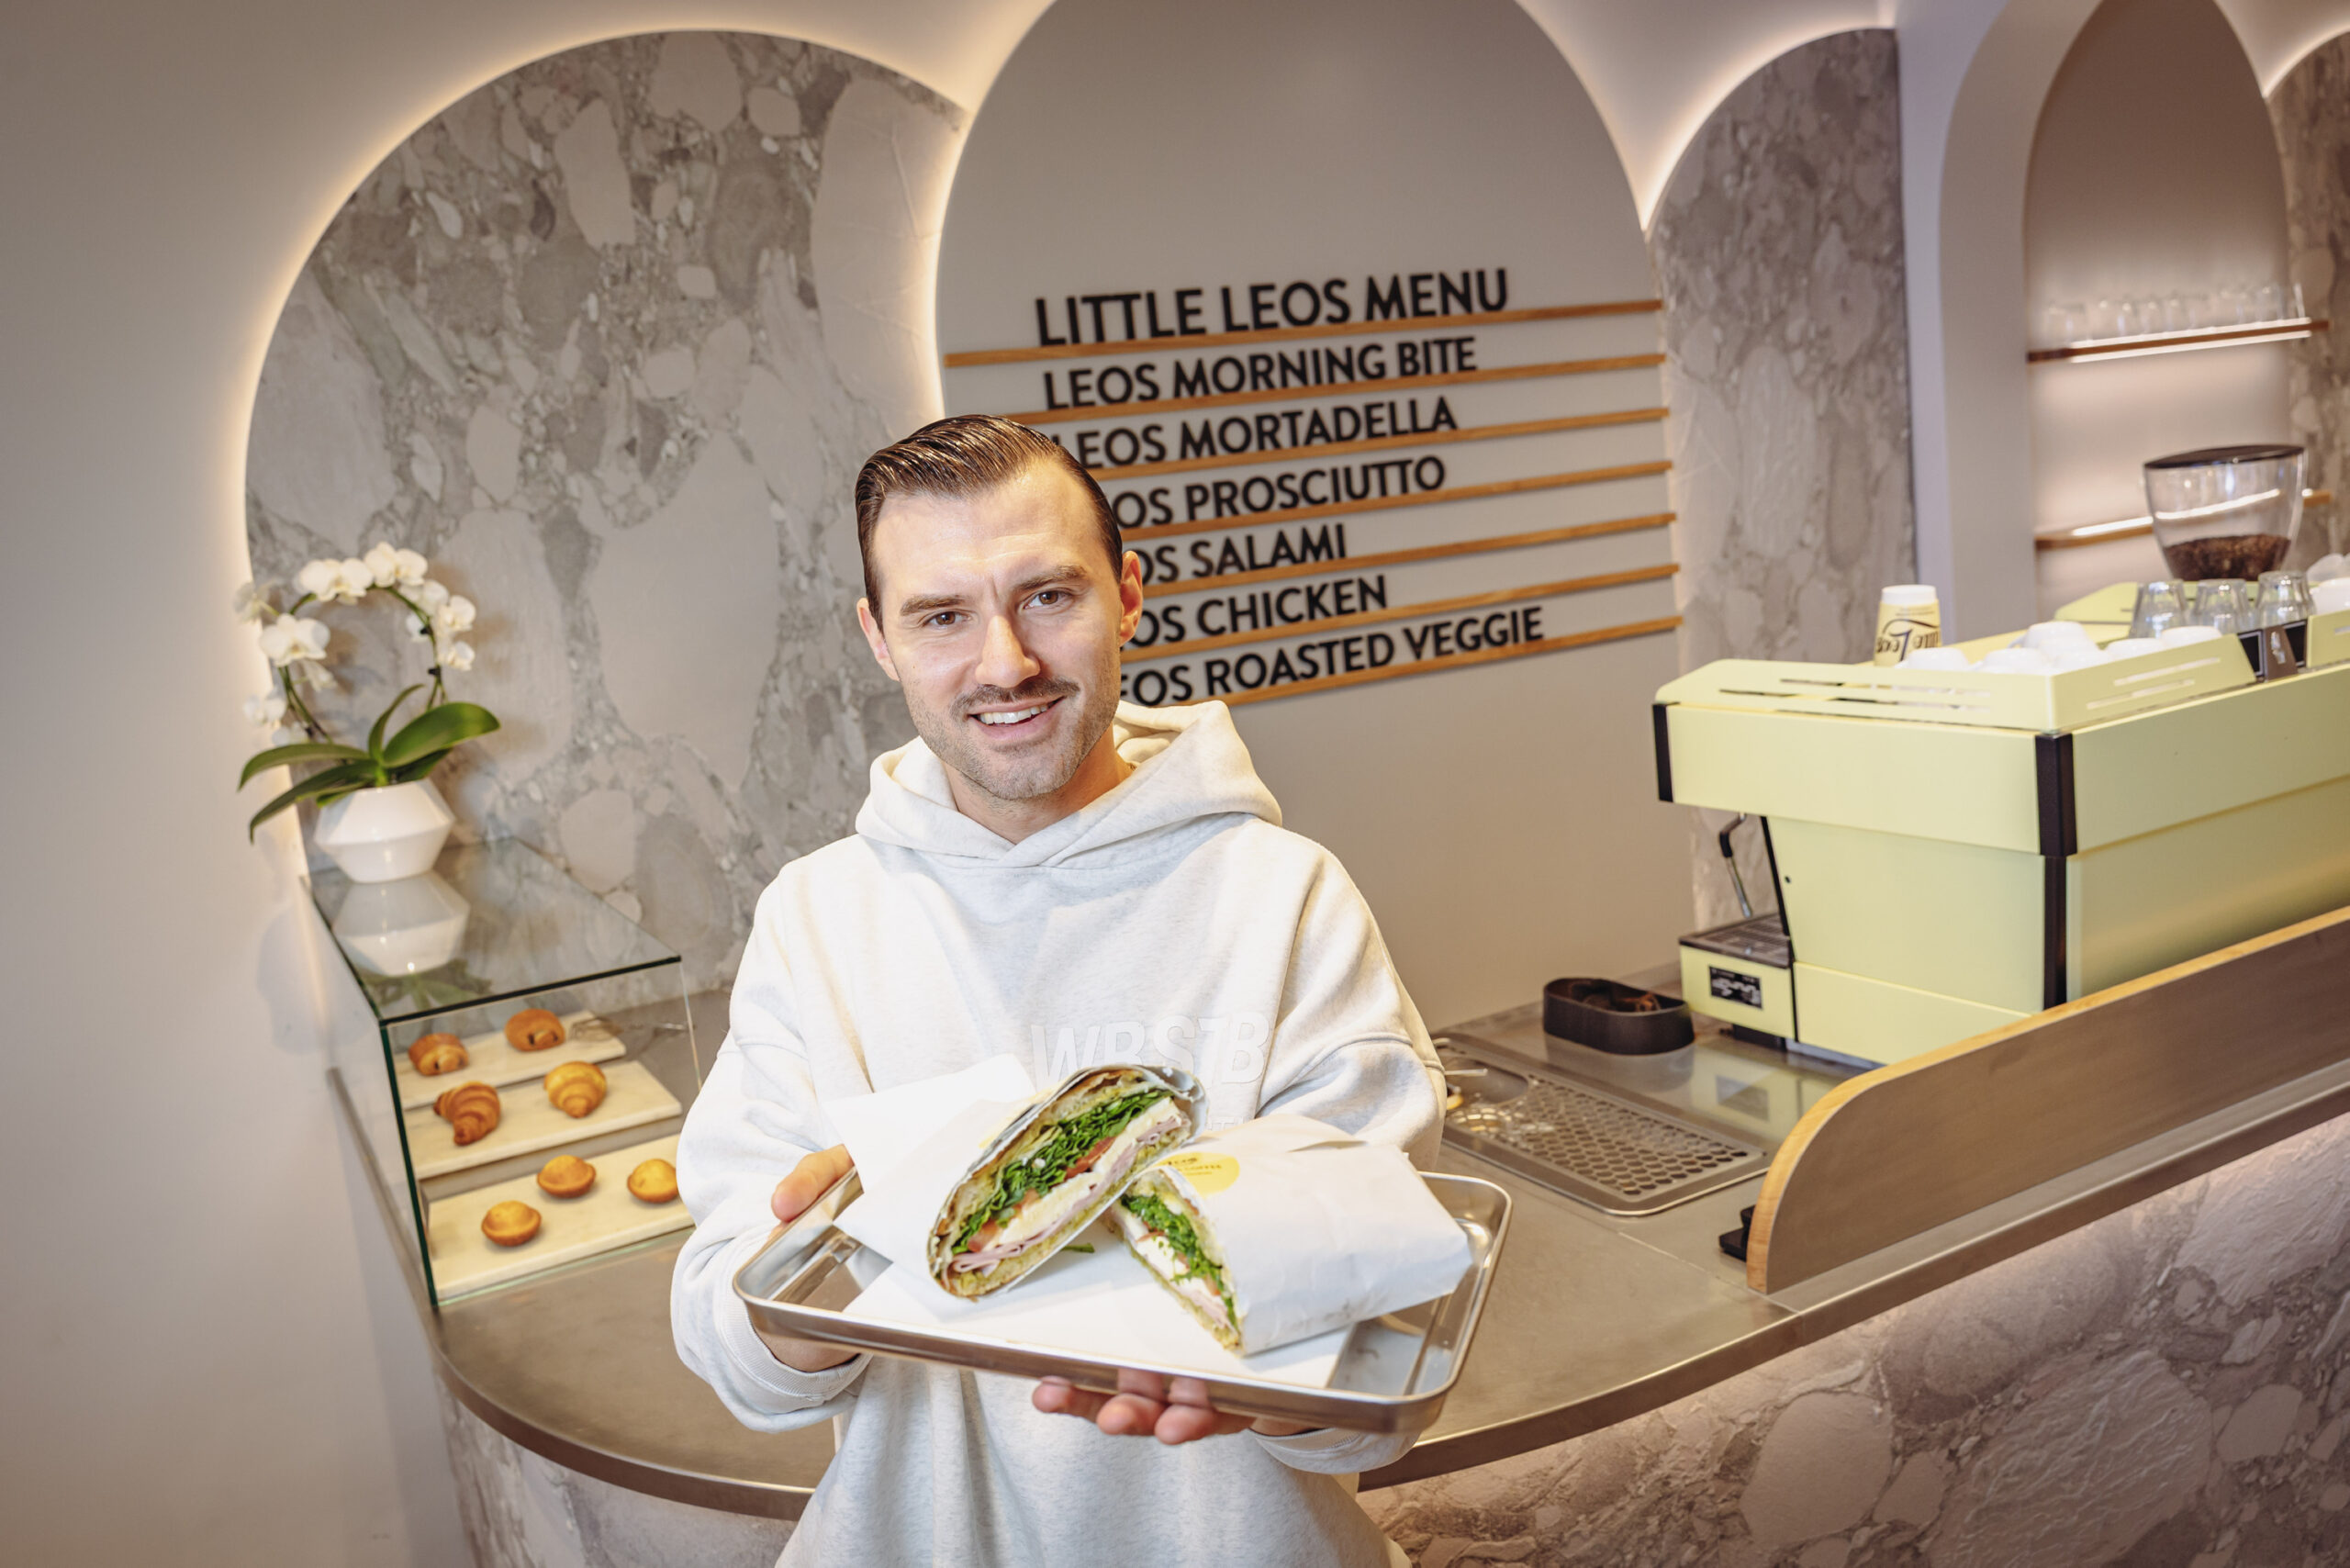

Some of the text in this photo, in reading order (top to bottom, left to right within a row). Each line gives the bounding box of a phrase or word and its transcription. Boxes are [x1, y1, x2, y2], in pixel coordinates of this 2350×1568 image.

[1035, 268, 1507, 347] LITTLE LEOS MENU
[1044, 336, 1478, 410] LEOS MORNING BITE
[1052, 395, 1458, 469] EOS MORTADELLA
[1112, 455, 1445, 530] OS PROSCIUTTO
[1190, 523, 1346, 577] SALAMI
[1120, 575, 1387, 651] OS CHICKEN
[1205, 633, 1395, 697] ROASTED
[1404, 607, 1544, 661] VEGGIE
